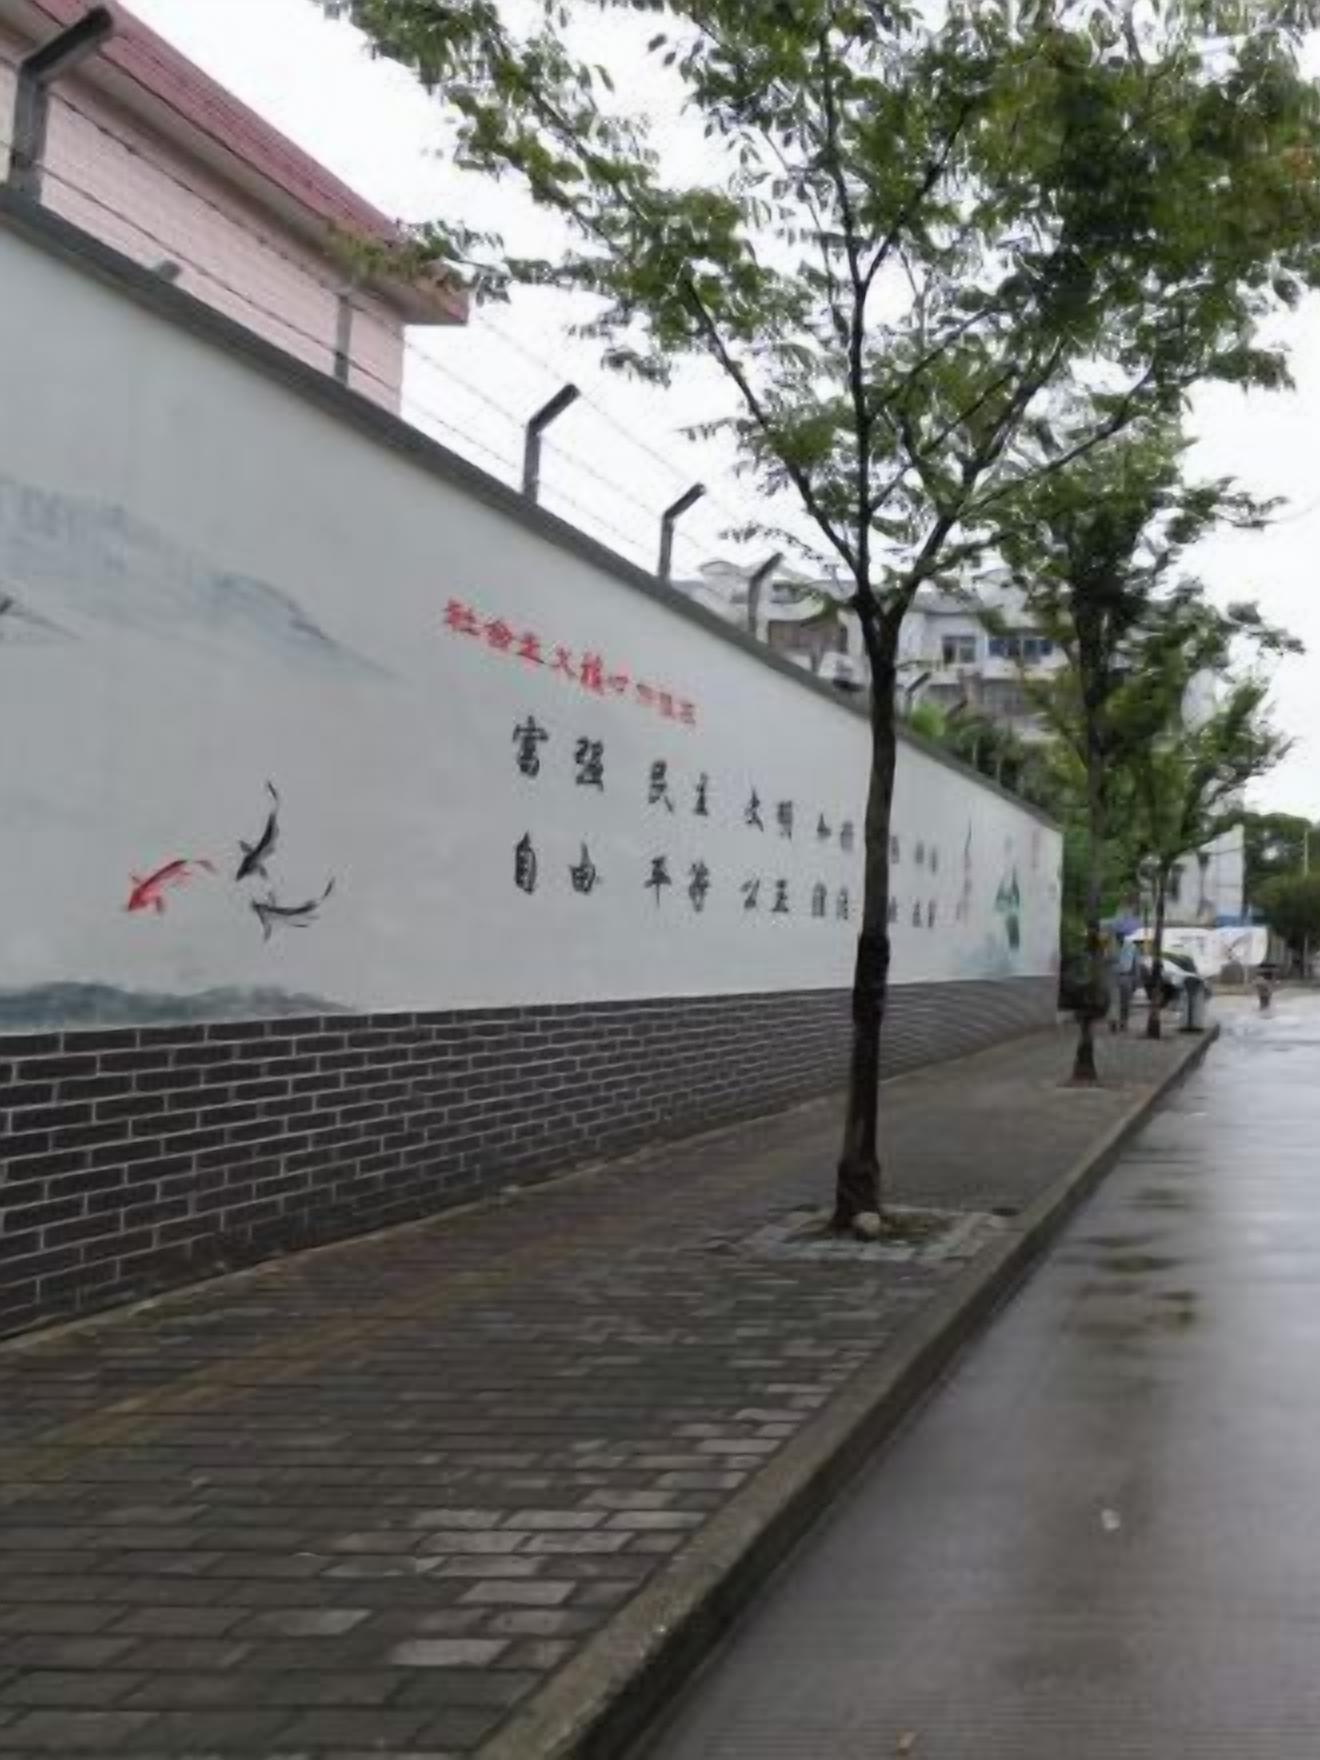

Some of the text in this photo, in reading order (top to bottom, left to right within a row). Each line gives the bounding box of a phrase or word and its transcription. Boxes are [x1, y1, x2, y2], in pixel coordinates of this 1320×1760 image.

[512, 714, 605, 792] 富强
[648, 758, 709, 817] 民主
[513, 831, 600, 895] 自由
